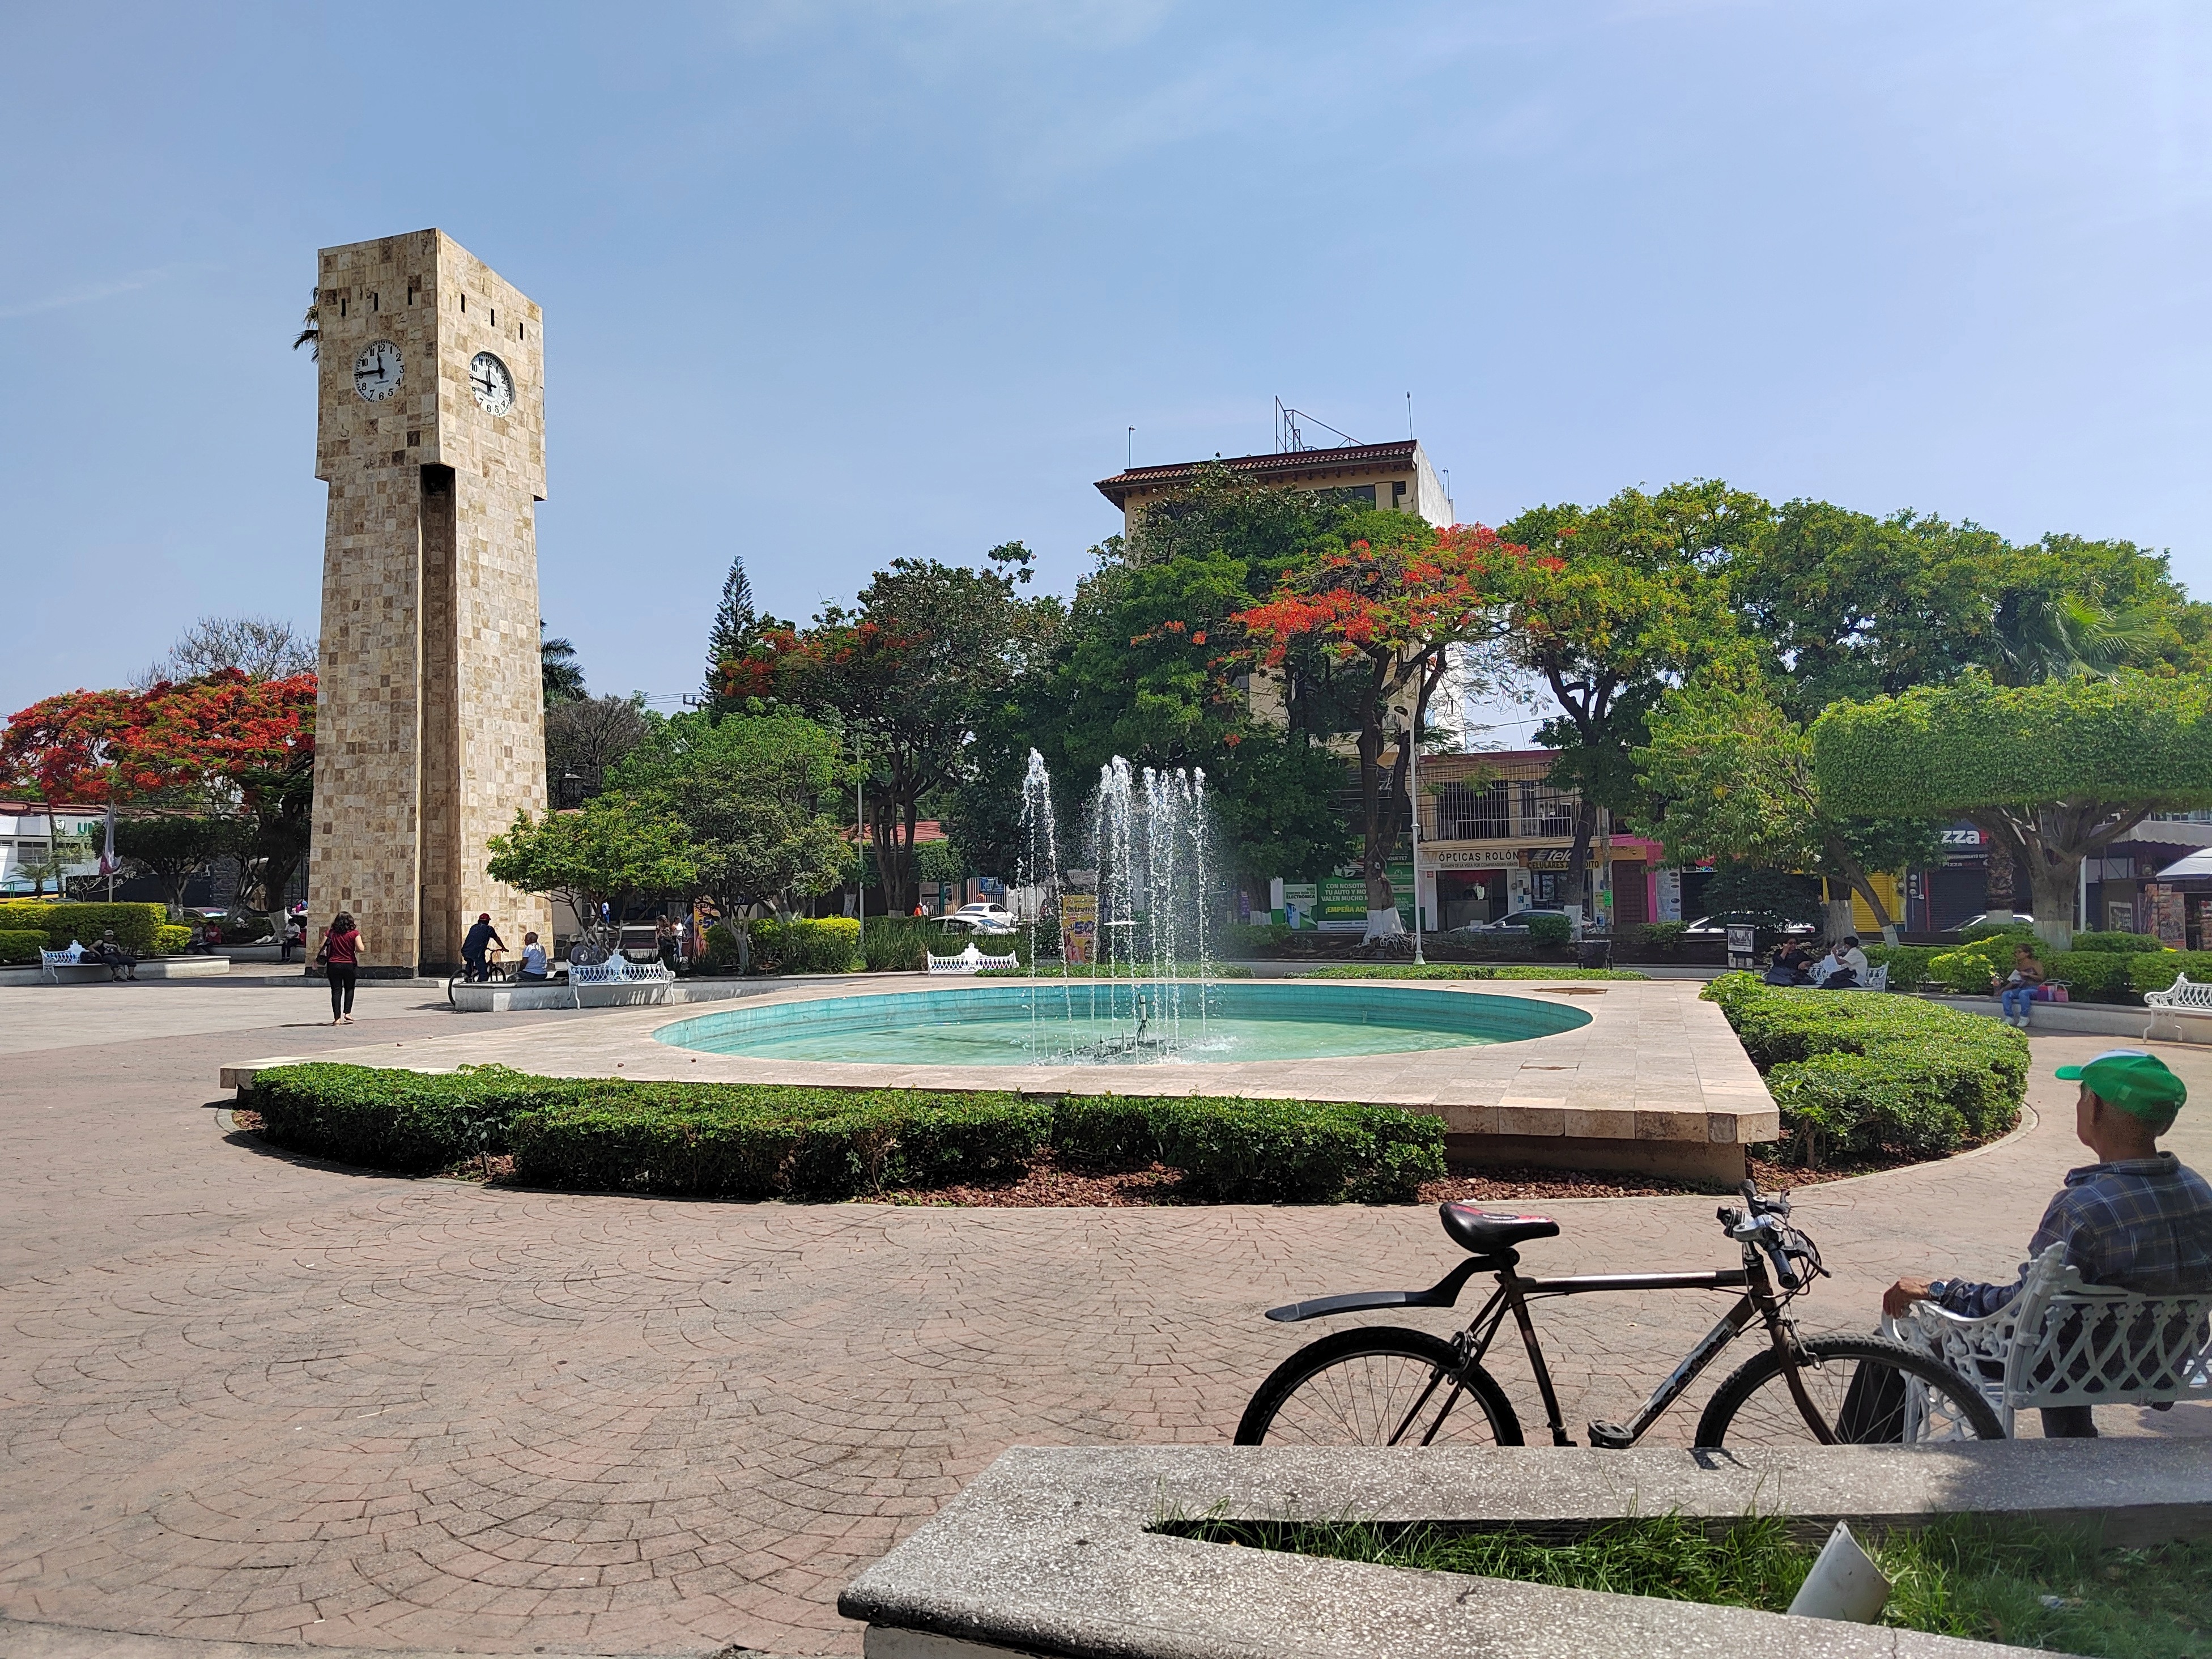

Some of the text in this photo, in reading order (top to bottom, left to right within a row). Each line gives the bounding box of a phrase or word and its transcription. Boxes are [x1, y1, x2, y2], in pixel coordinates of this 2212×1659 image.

[369, 348, 375, 356] 11
[378, 343, 385, 352] 12
[390, 346, 393, 354] 1
[396, 353, 401, 361] 2
[478, 357, 483, 366] 11
[361, 358, 368, 367] 10
[486, 358, 492, 368] 12
[399, 365, 405, 373] 3
[471, 363, 478, 372] 10
[395, 377, 401, 386] 4
[369, 389, 375, 398] 7
[495, 405, 499, 413] 5
[1940, 830, 1980, 844] zza
[1485, 849, 1518, 861] ROLÓN
[1325, 905, 1354, 914] ¡EMPEÑA
